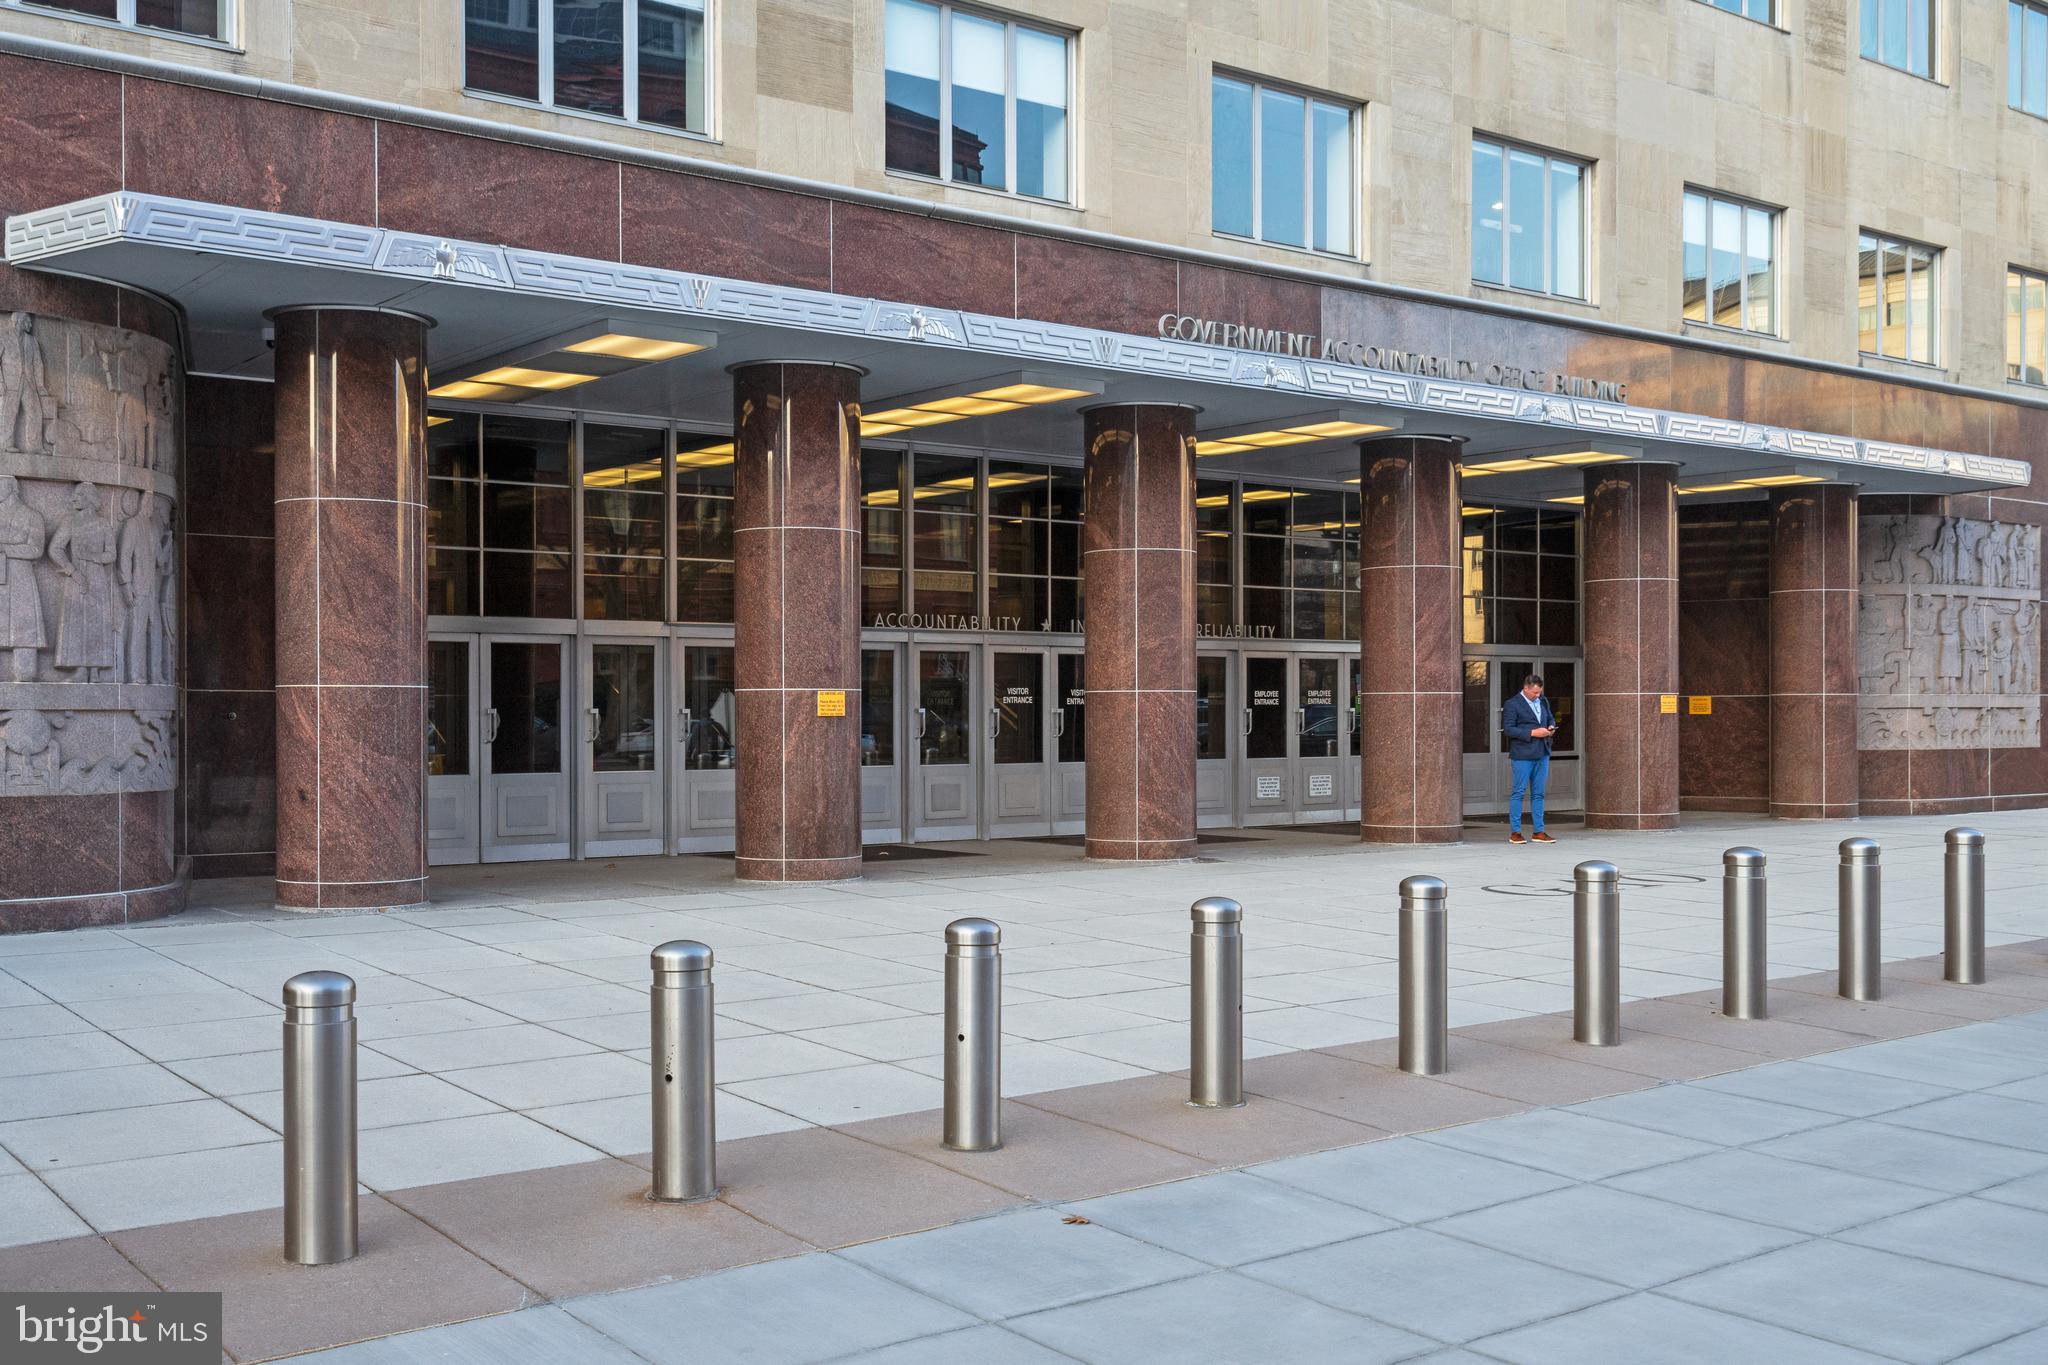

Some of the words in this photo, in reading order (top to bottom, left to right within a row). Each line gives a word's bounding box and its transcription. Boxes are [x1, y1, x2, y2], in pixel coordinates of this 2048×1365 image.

[1158, 313, 1316, 358] GOVERNMENT
[1321, 338, 1478, 381] ACCOUNTABILITY
[1485, 364, 1546, 392] OFFICE
[1552, 374, 1628, 403] BUILDING
[874, 612, 1021, 632] ACCOUNTABILITY
[1196, 623, 1276, 639] RELIABILITY
[1007, 687, 1029, 695] VISITOR
[1070, 688, 1085, 697] VISIT
[1254, 690, 1279, 698] EMPLOYEE
[1307, 689, 1332, 697] EMPLOYEE
[1003, 696, 1033, 704] ENTRANCE
[1066, 697, 1084, 705] ENTRA
[1254, 698, 1279, 706] ENTRANCE
[1307, 697, 1332, 705] ENTRANCE
[1481, 872, 1707, 897] GO
